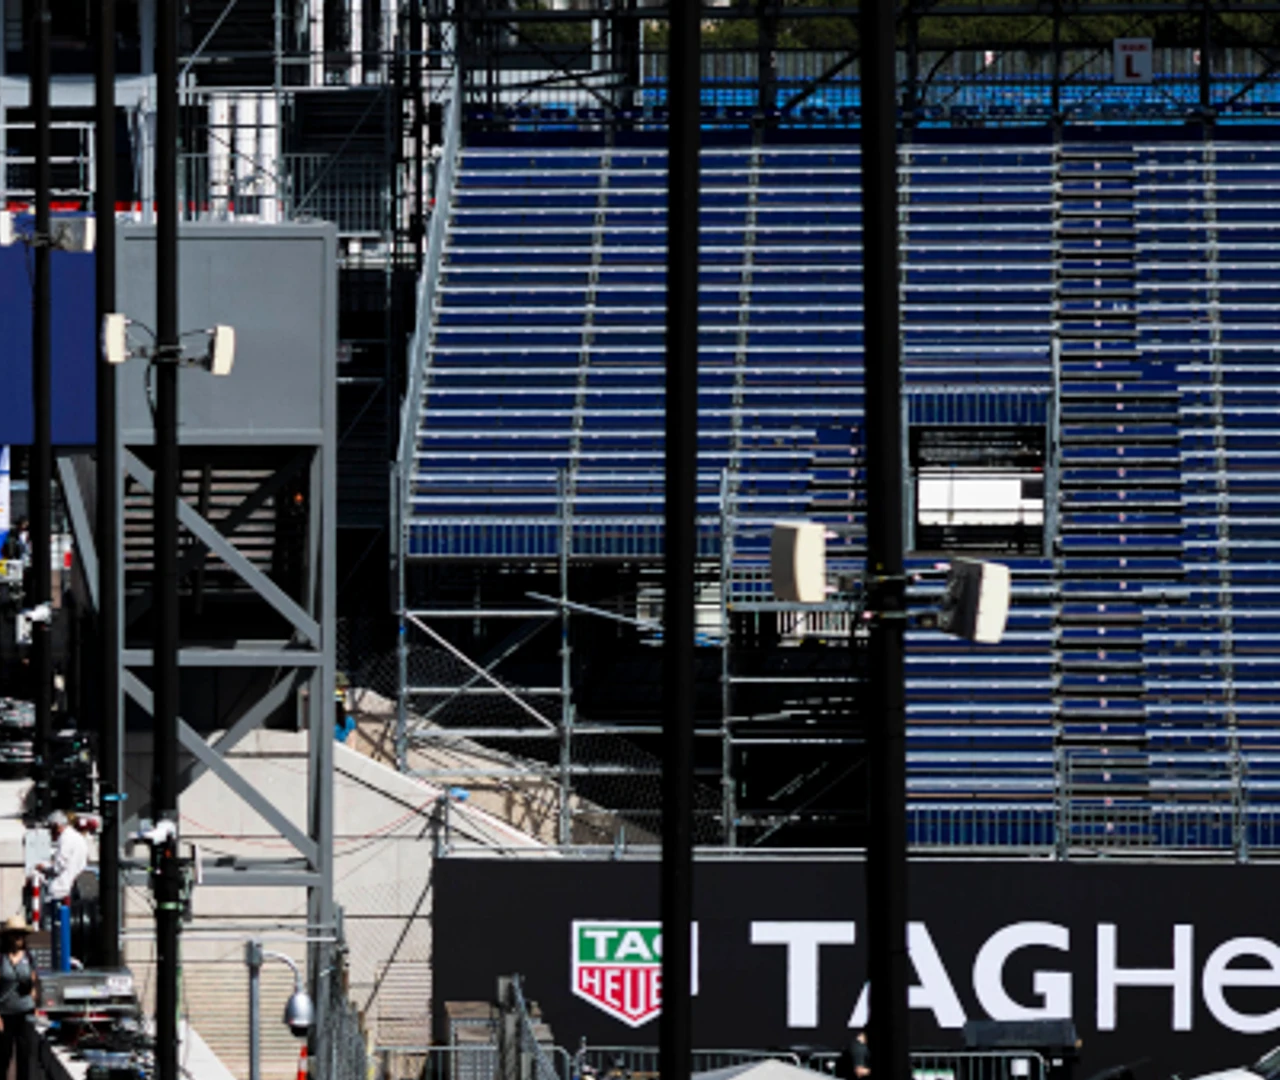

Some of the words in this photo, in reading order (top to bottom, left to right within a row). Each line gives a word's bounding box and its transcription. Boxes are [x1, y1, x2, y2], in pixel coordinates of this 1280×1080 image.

[1125, 54, 1141, 78] L
[583, 930, 663, 961] TA
[580, 969, 663, 1018] HEUE
